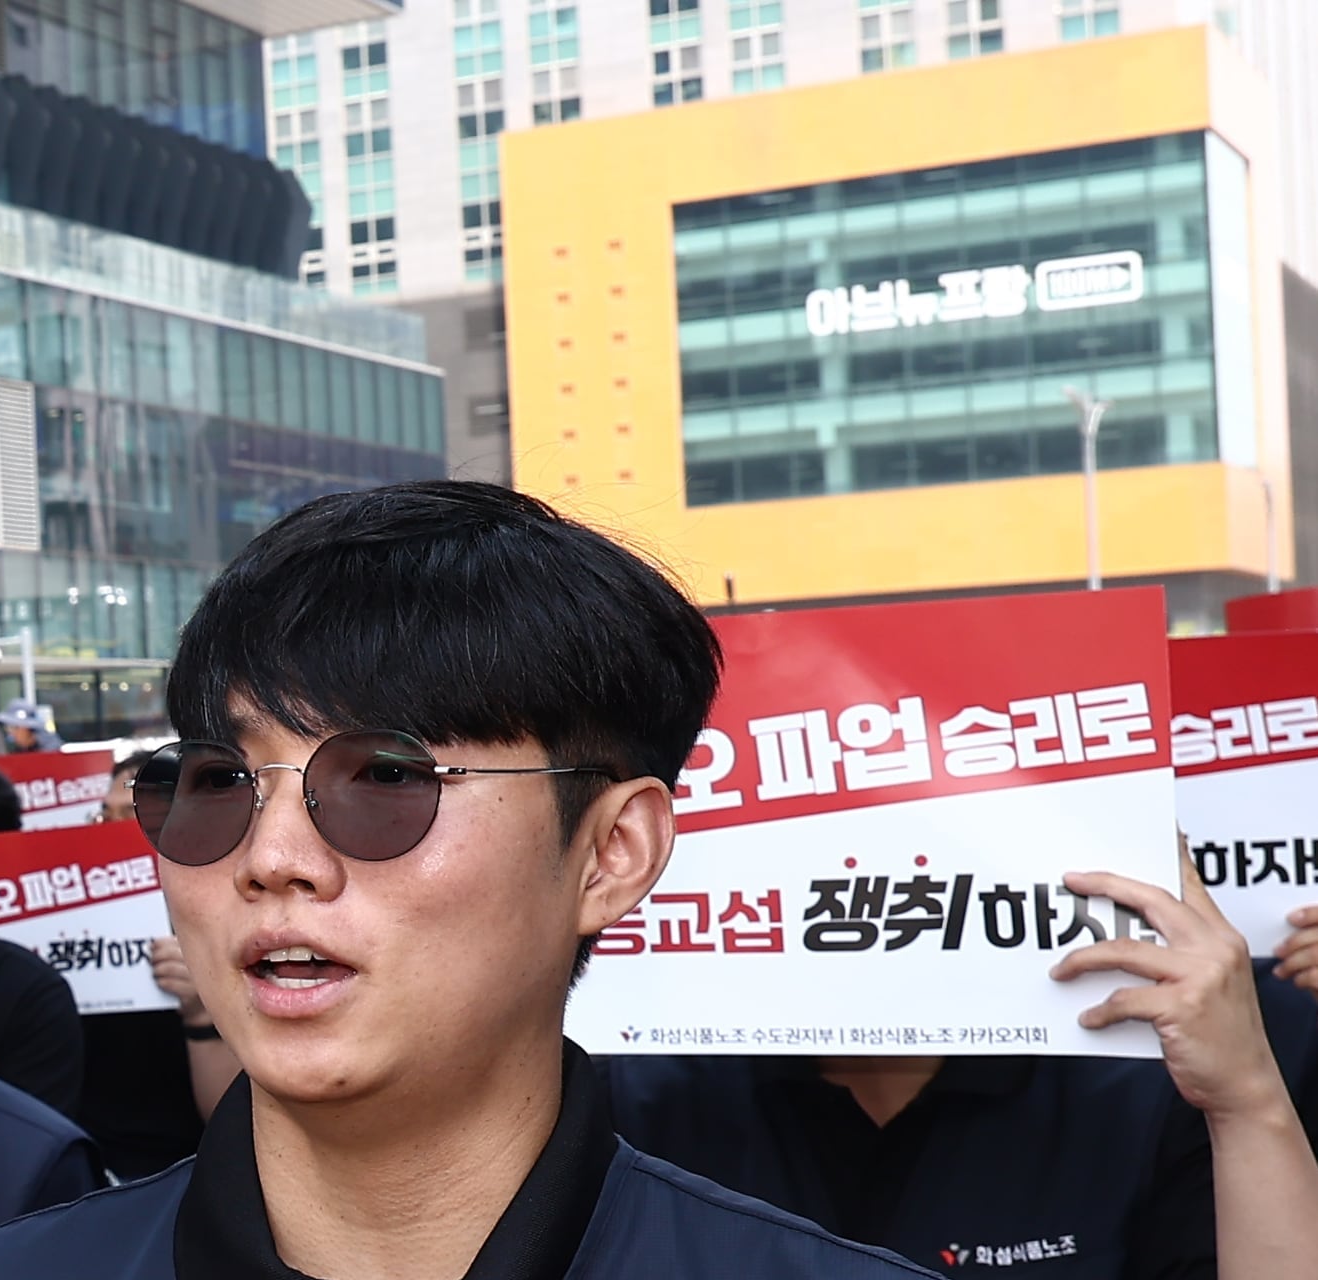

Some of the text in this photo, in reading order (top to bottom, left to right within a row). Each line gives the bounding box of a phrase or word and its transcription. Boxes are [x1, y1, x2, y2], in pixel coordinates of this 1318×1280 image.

[748, 695, 932, 802] 파업
[939, 683, 1158, 779] 승리로
[1170, 696, 1318, 767] 승리로
[19, 863, 88, 912] 파업
[83, 854, 159, 899] 승리로
[803, 873, 972, 952] 쟁취
[649, 1026, 748, 1045] 화섬식품노조
[751, 1026, 835, 1046] 수도권지부
[849, 1026, 956, 1045] 화섬식품노조
[958, 1026, 1049, 1046] 카카오지회
[975, 1234, 1078, 1267] 화섬식품노조
